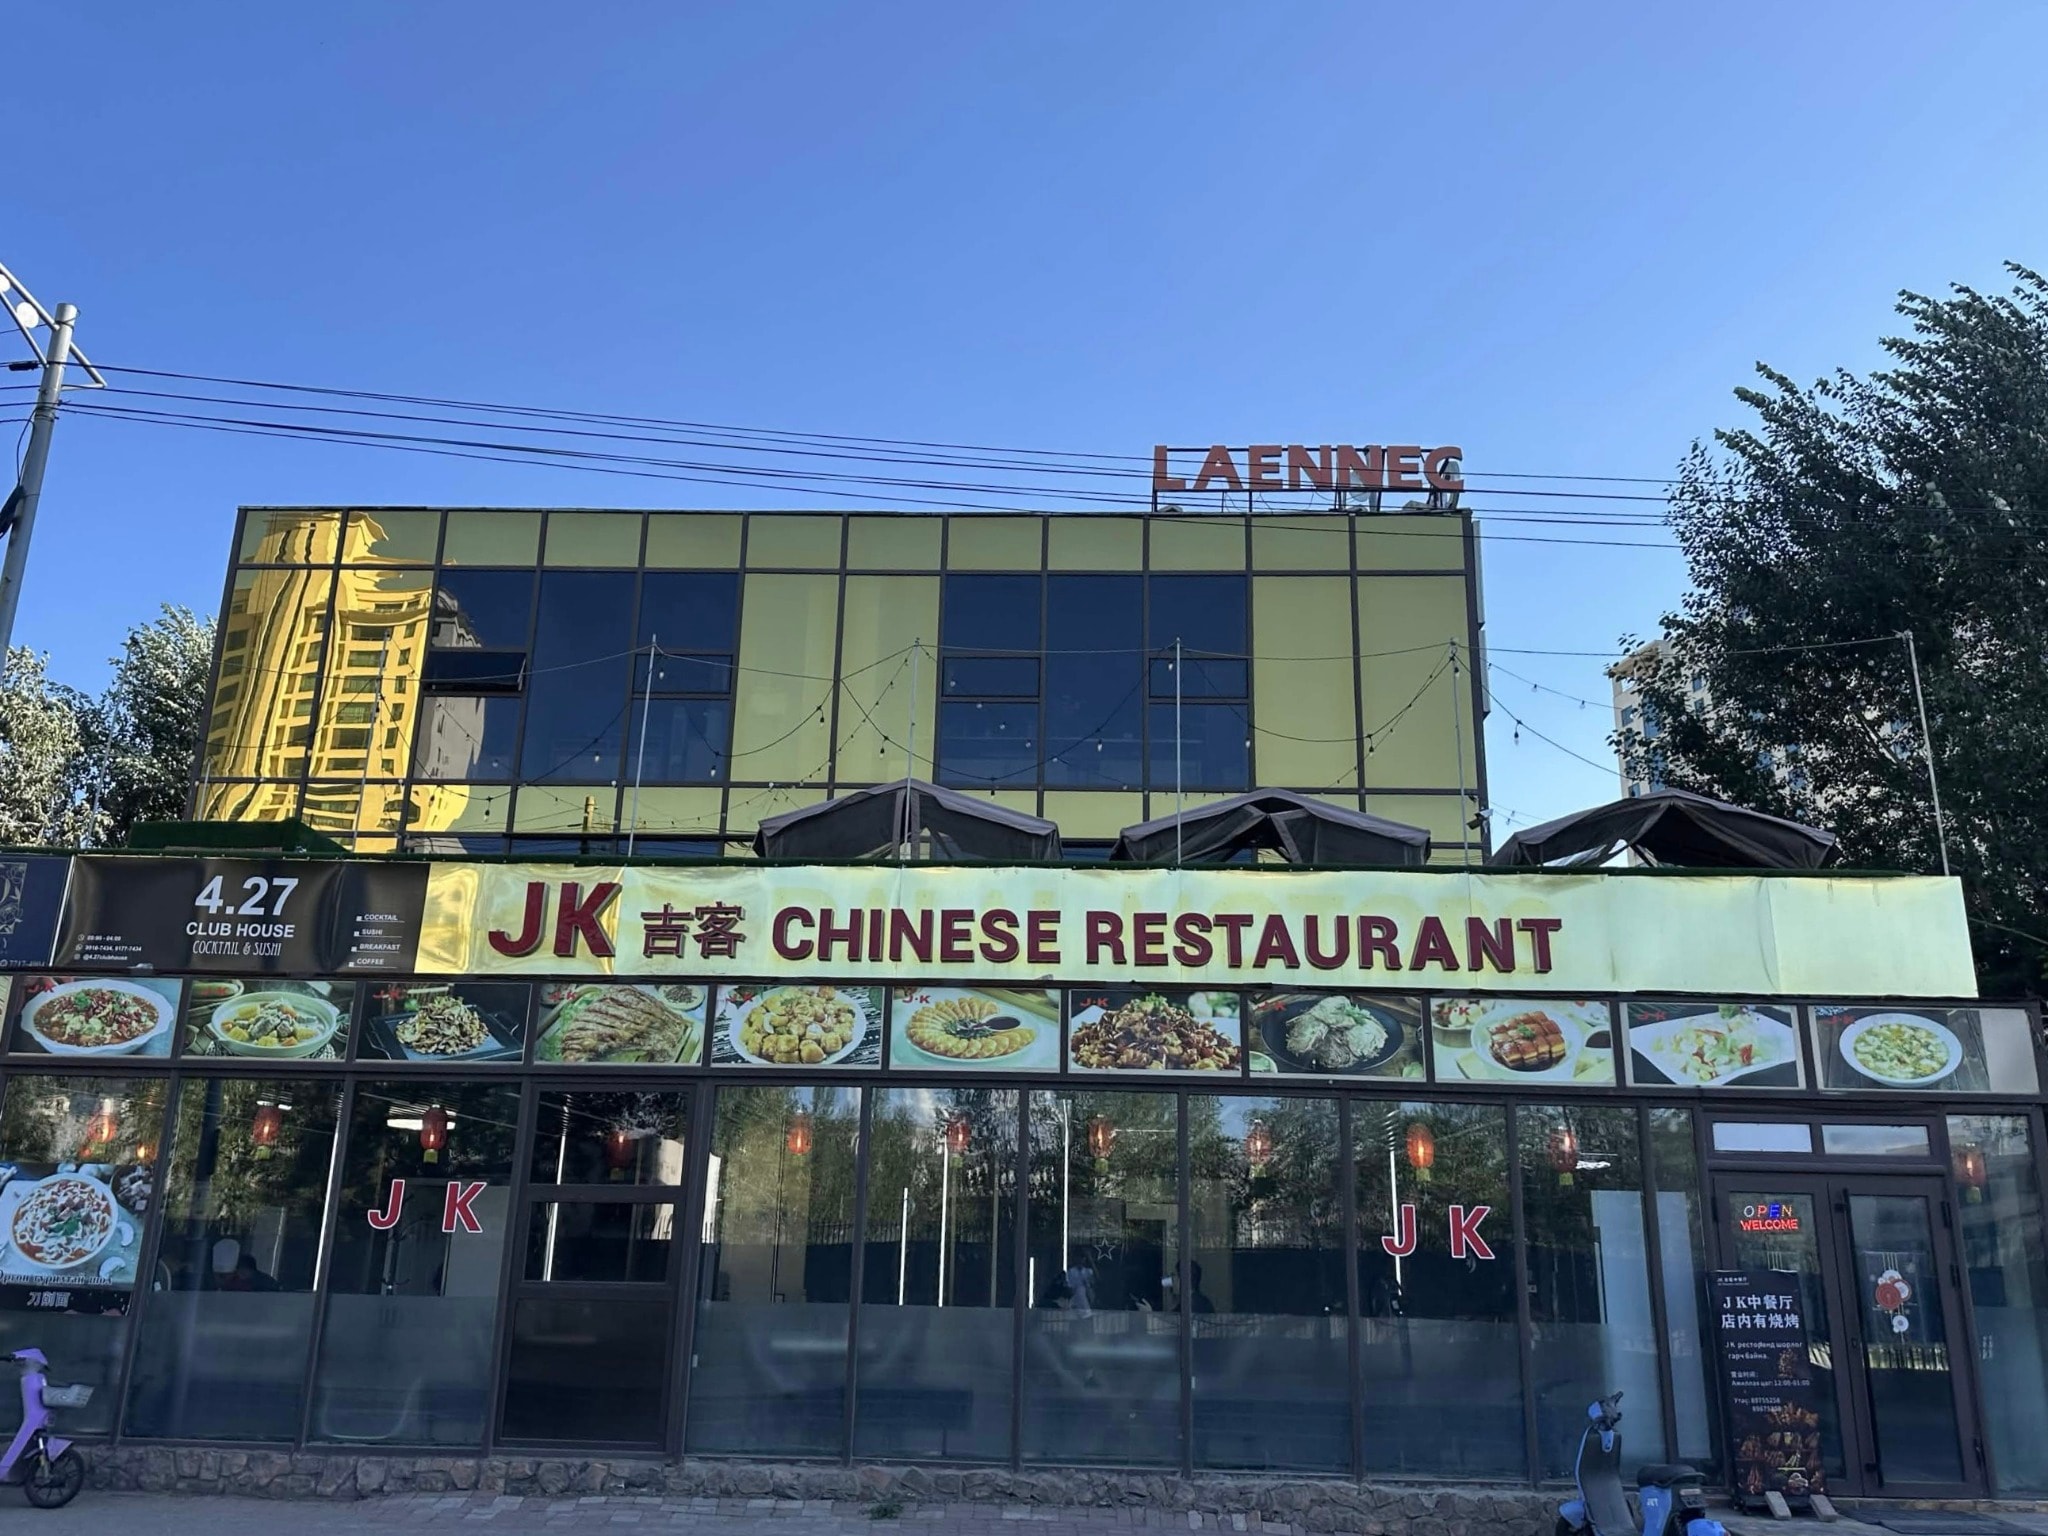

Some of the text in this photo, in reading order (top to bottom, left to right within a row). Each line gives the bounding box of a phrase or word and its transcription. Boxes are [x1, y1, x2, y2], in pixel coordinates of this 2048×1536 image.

[1153, 445, 1464, 490] LAENNEC
[195, 875, 299, 916] 4.27
[186, 922, 295, 938] CLUB HOUSE
[488, 881, 1563, 974] JK 吉客 CHINESE RESTAURANT
[192, 940, 282, 956] COCKTAIL & SUSHI
[367, 1179, 488, 1233] J K
[1743, 1203, 1793, 1218] OPEN
[1381, 1203, 1496, 1259] J K
[1740, 1218, 1799, 1231] WELCOME
[1721, 1313, 1800, 1329] 店内有烧烤
